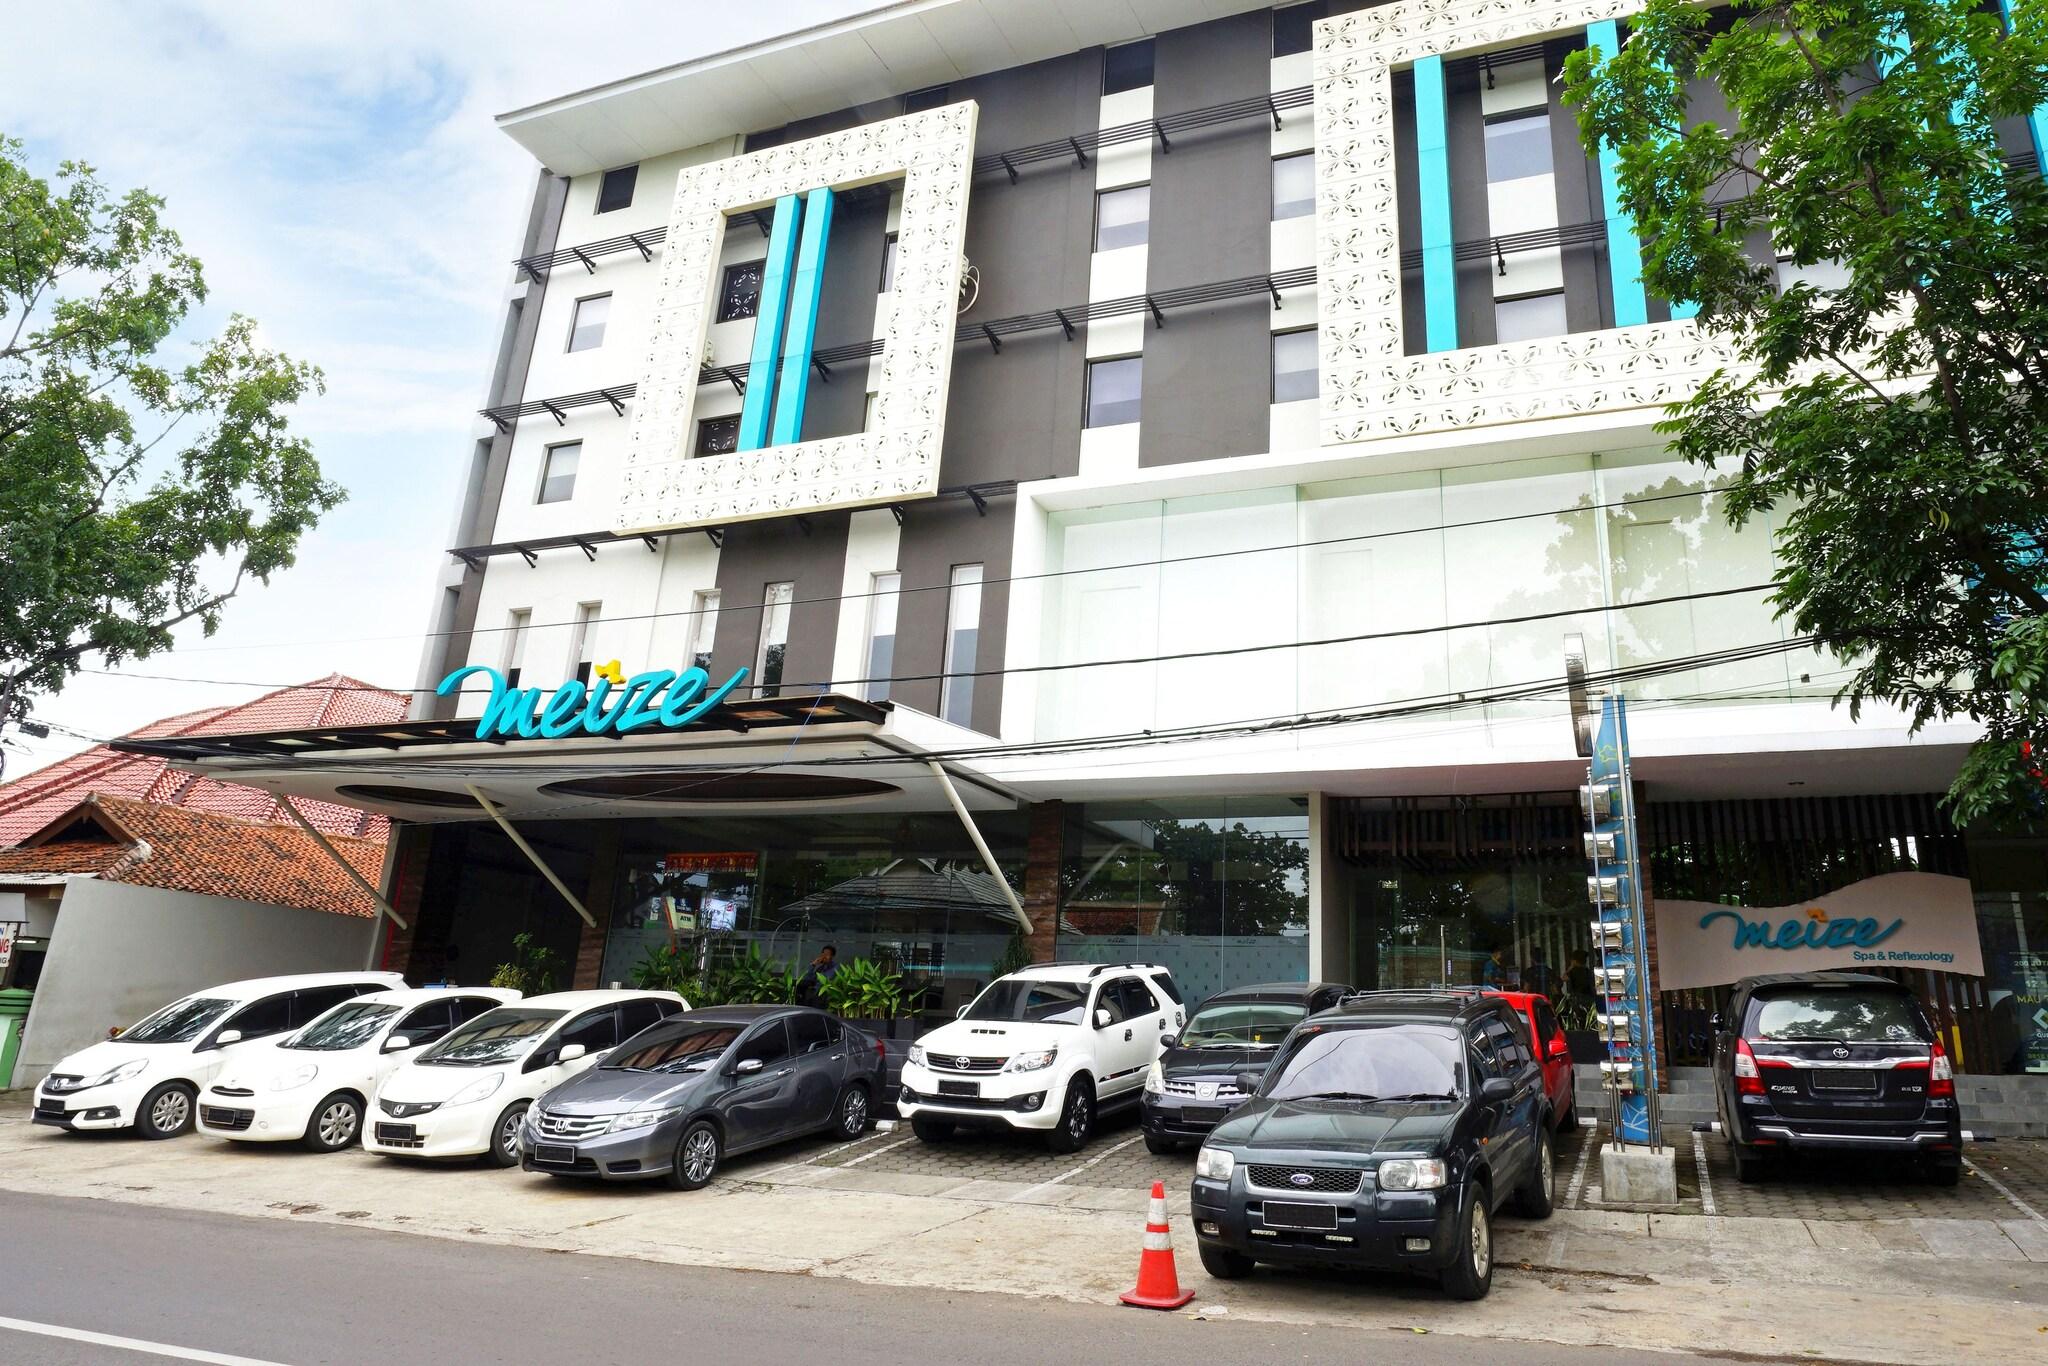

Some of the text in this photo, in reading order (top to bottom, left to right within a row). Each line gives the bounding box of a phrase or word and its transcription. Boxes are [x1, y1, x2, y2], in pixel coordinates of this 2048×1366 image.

[437, 659, 749, 740] meize
[1699, 908, 1902, 950] meize
[1853, 951, 1954, 963] Spa & Reflexology
